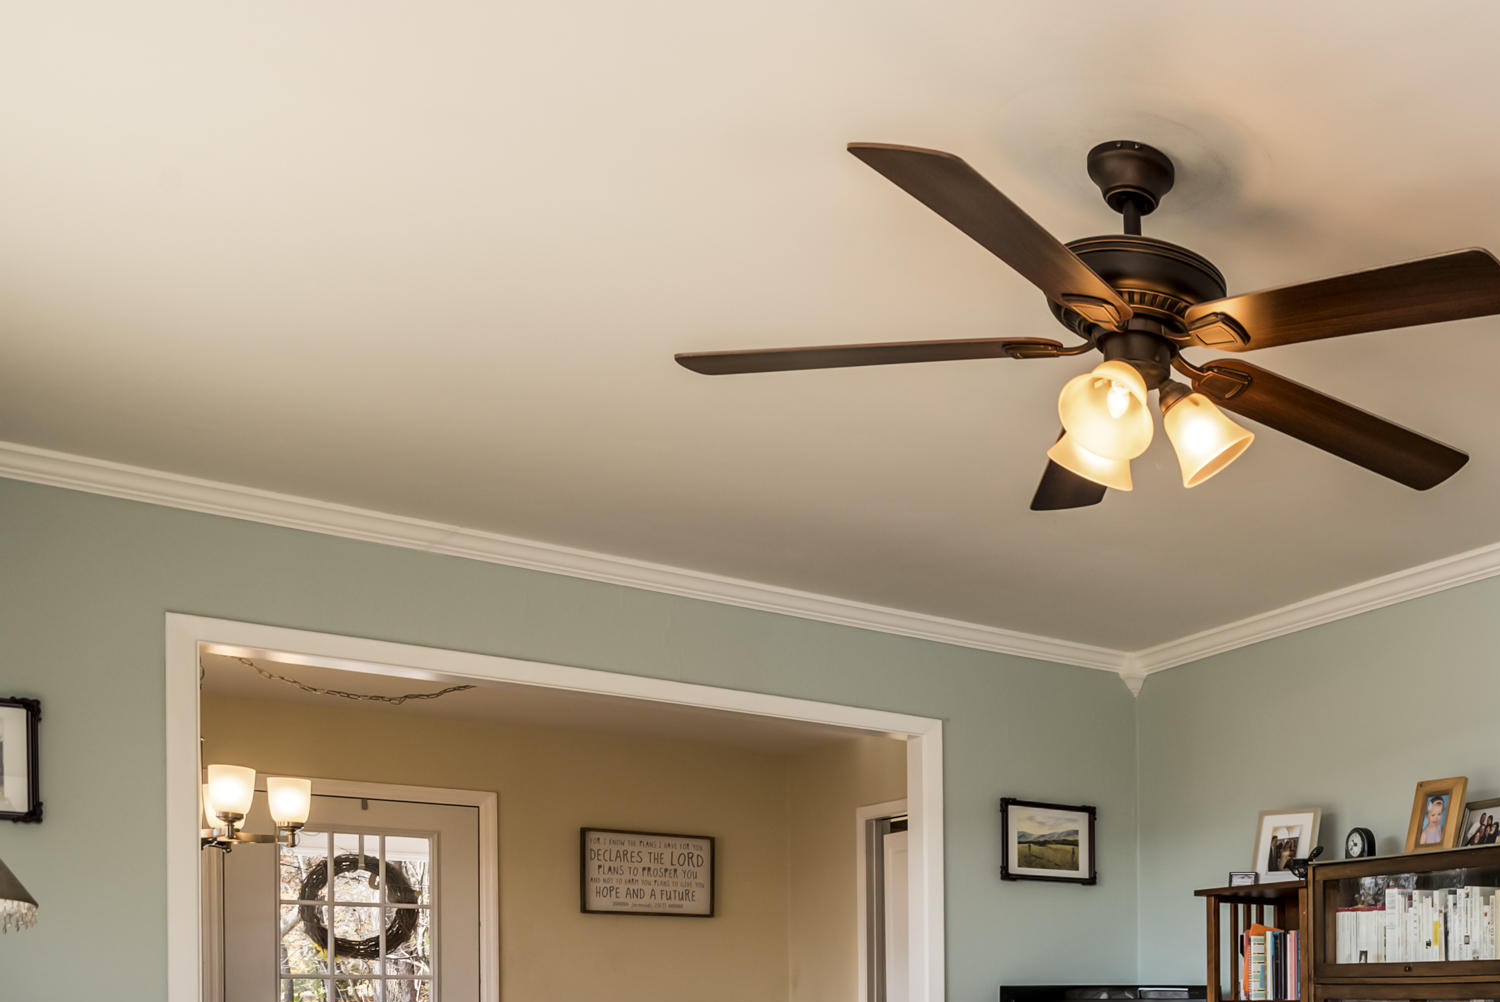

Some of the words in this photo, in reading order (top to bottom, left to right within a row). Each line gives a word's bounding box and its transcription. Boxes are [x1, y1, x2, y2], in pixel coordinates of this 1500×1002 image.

[590, 848, 643, 864] DECLARES
[648, 851, 664, 865] THE
[671, 851, 704, 868] LORD
[598, 864, 624, 876] PLANS
[628, 866, 639, 877] TO
[642, 866, 678, 879] PROSPER
[681, 869, 698, 880] YOU
[596, 885, 620, 899] HOPE
[625, 887, 645, 899] AND
[650, 888, 656, 900] A
[660, 888, 696, 902] FUTURE
